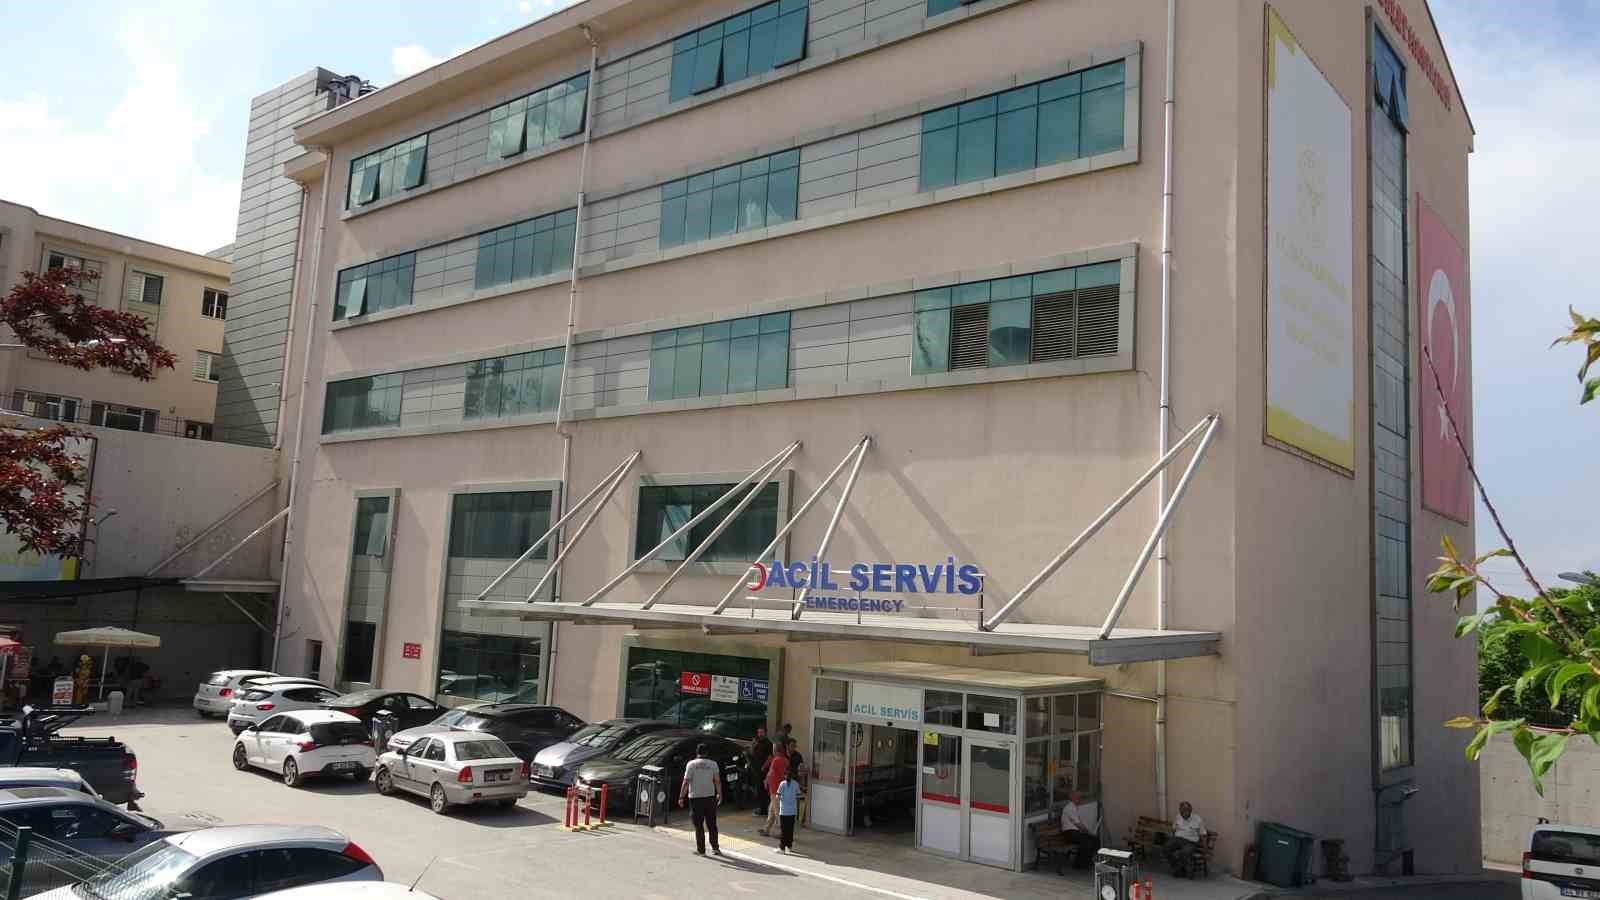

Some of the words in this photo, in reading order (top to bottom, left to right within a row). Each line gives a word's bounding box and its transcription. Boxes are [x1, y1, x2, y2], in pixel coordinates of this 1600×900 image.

[766, 556, 837, 590] ACİL
[850, 556, 982, 594] SERVİS
[805, 596, 904, 613] EMERGENCY
[880, 706, 919, 720] SERVİS
